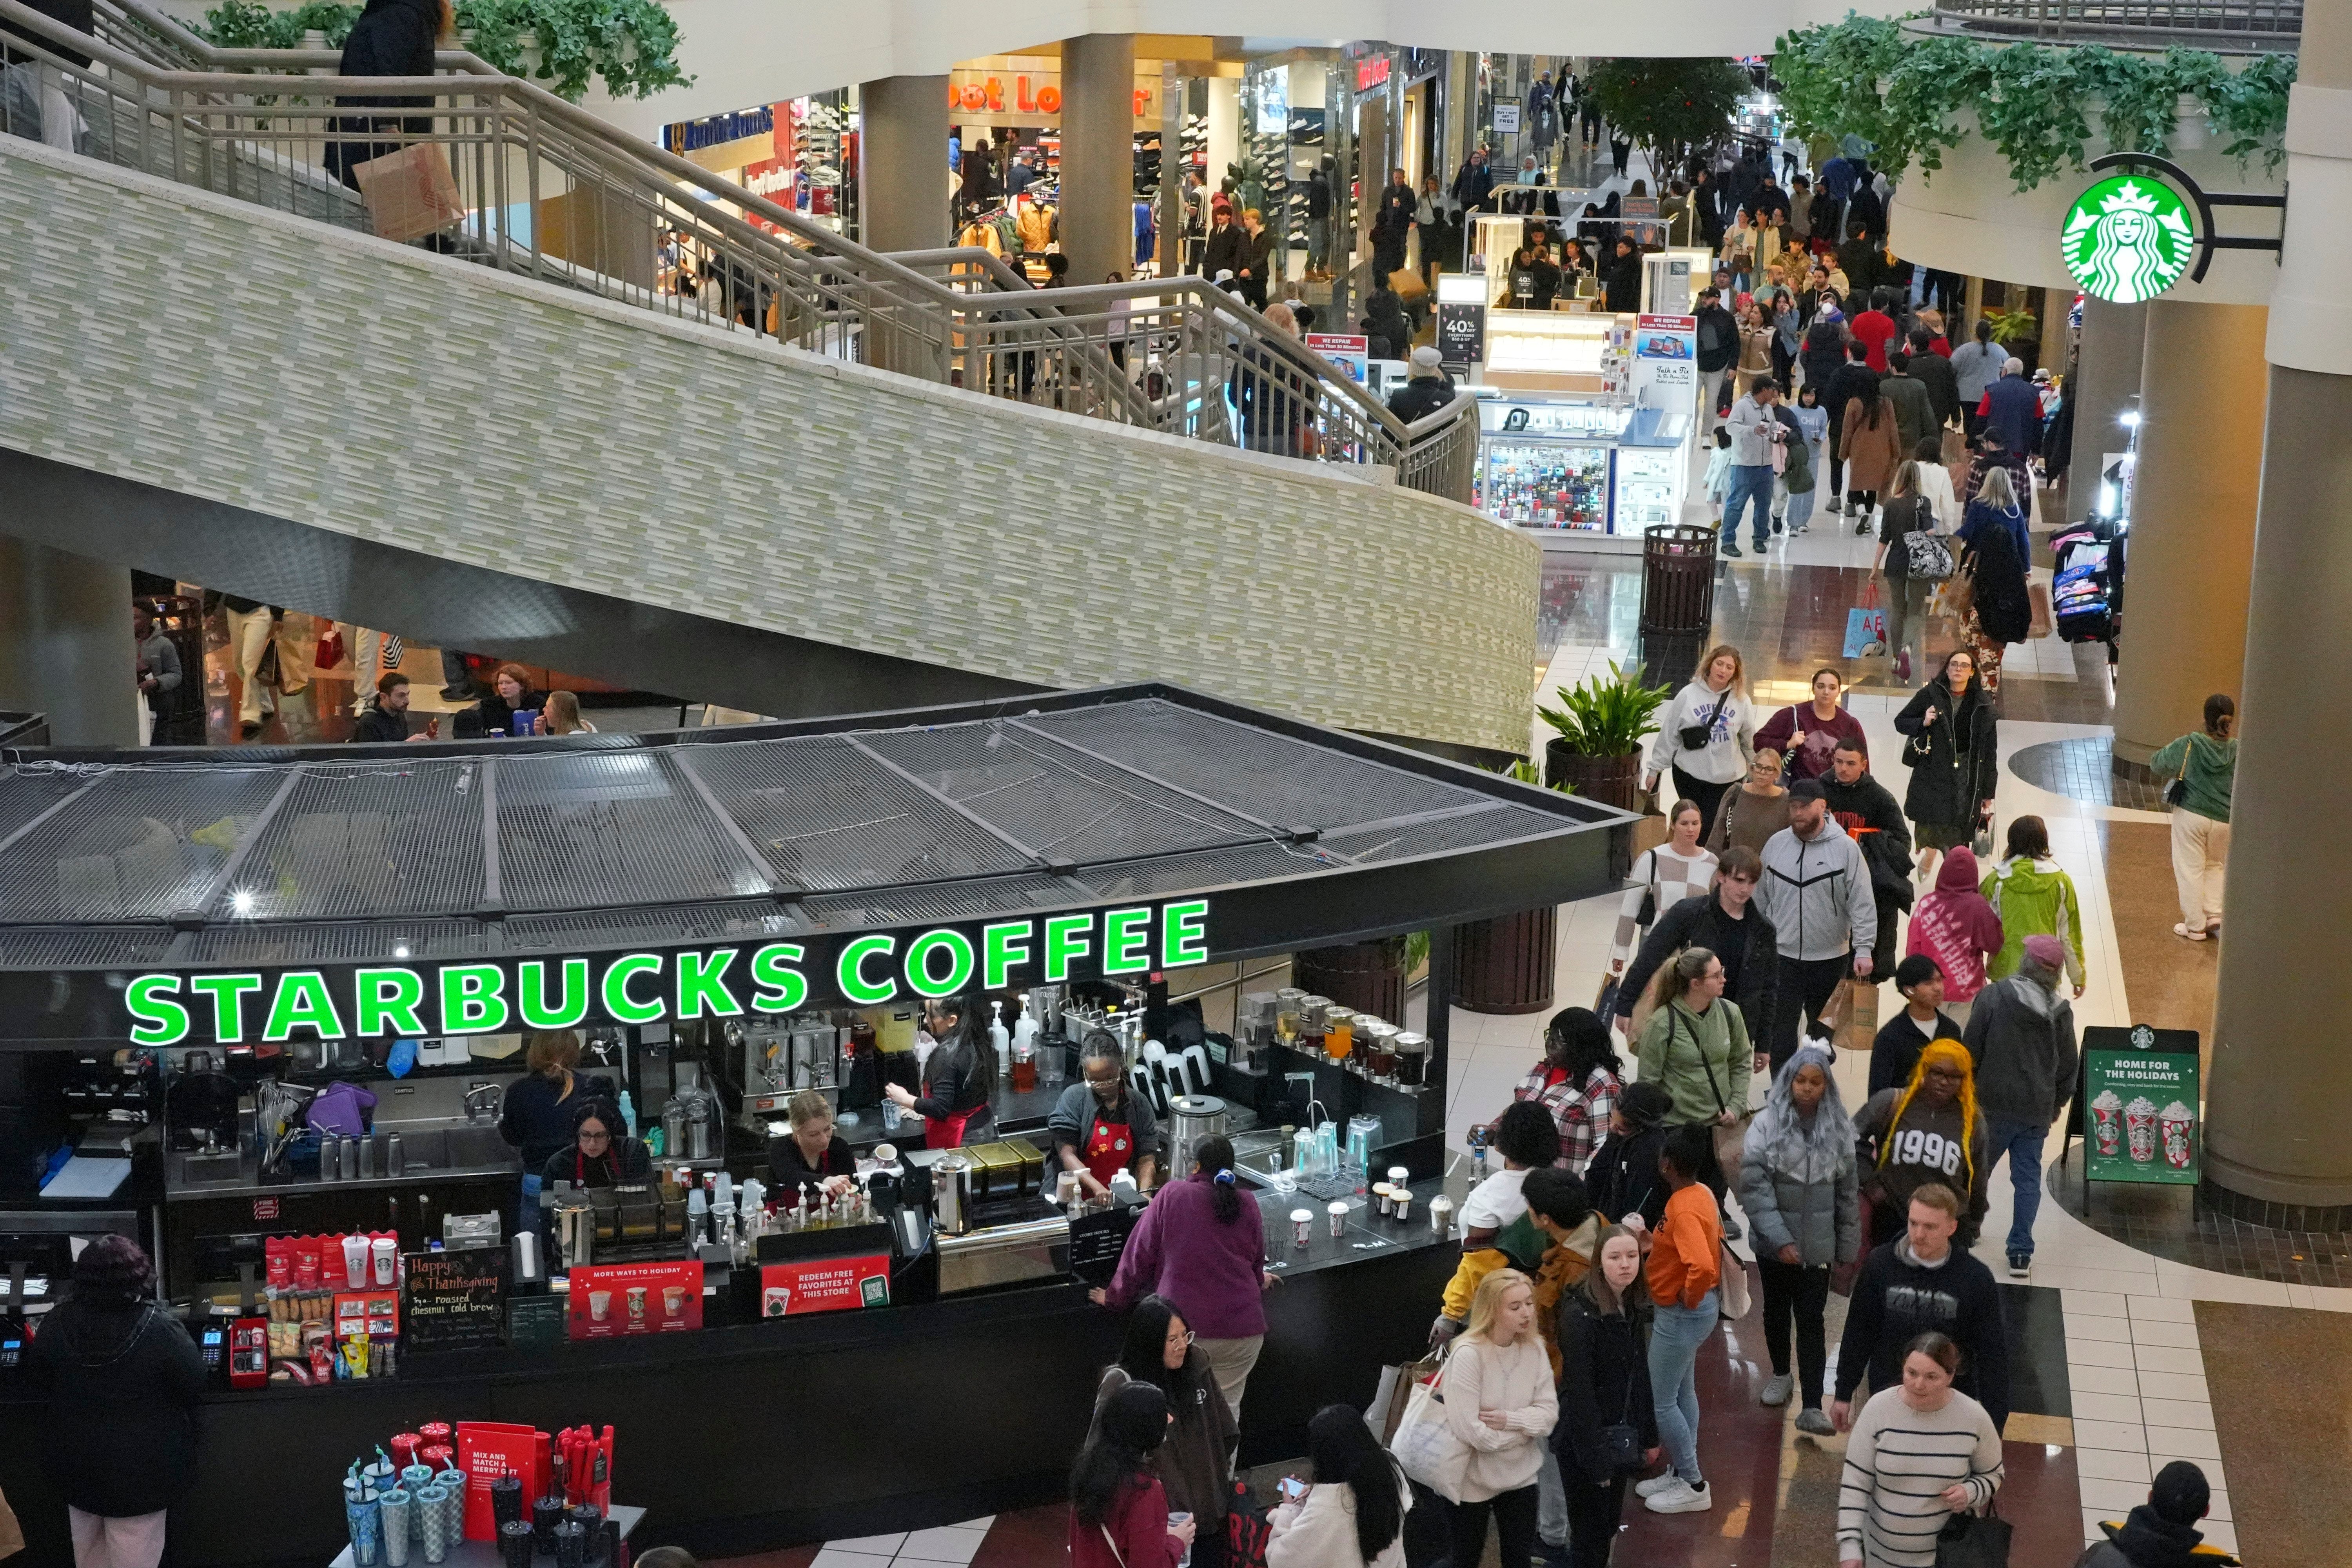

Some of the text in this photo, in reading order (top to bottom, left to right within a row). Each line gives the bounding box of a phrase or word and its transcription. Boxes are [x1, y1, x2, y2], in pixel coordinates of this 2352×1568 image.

[1693, 704, 1735, 718] BUFFLO
[125, 899, 1208, 1047] STARBUCKS COFFEE
[2115, 1060, 2170, 1070] HOME FOR
[2105, 1070, 2179, 1081] THE HOLIDAYS
[1892, 1129, 1961, 1176] 1996
[412, 1258, 450, 1277] Happy
[799, 1272, 832, 1282] REDEEM
[426, 1276, 498, 1293] Thanksgiving
[798, 1279, 842, 1290] FAVORITES
[823, 1287, 849, 1296] STORE
[413, 1297, 422, 1307] Try
[436, 1292, 470, 1304] roasted
[411, 1303, 494, 1316] chestnut cold brew
[473, 1458, 499, 1467] MATCH
